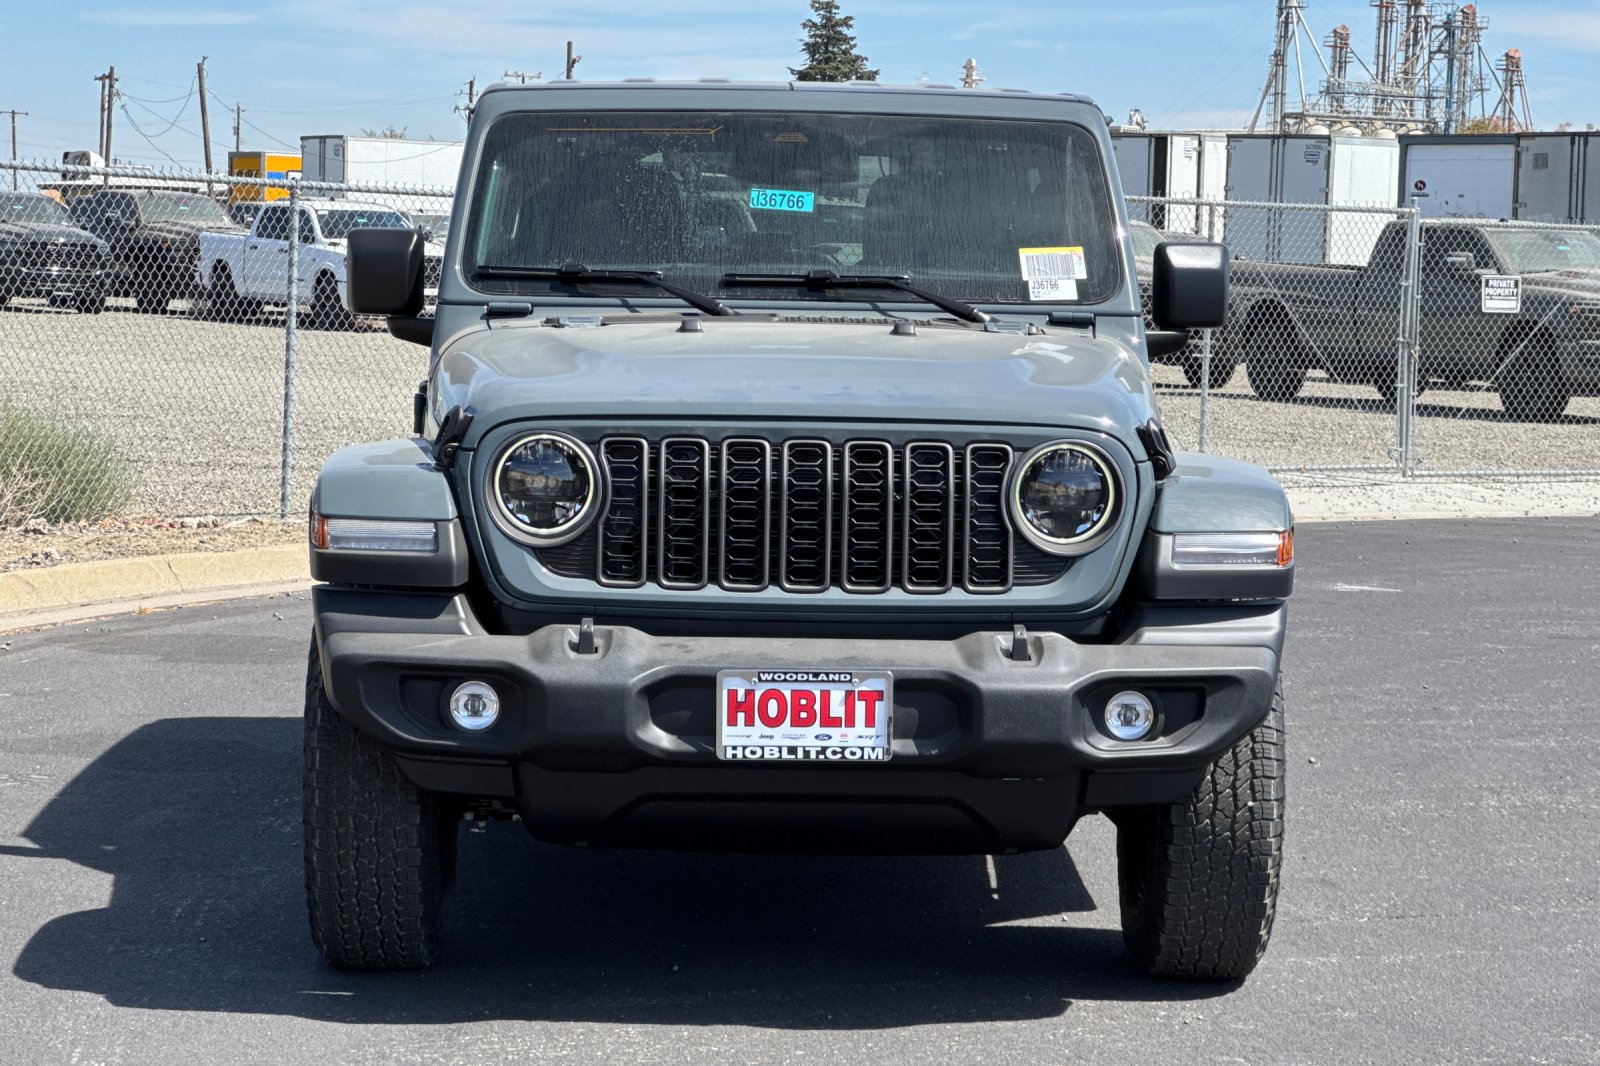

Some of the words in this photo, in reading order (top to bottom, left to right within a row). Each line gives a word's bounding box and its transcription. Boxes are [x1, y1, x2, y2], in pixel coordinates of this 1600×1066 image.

[751, 190, 805, 209] J36766
[1031, 280, 1059, 290] J36766
[1488, 279, 1515, 288] PRIVATE
[1485, 287, 1518, 296] PROPERTY
[759, 672, 851, 682] WOODLAND
[727, 688, 884, 728] HOBLIT
[725, 746, 884, 760] HOBLIT.COM
